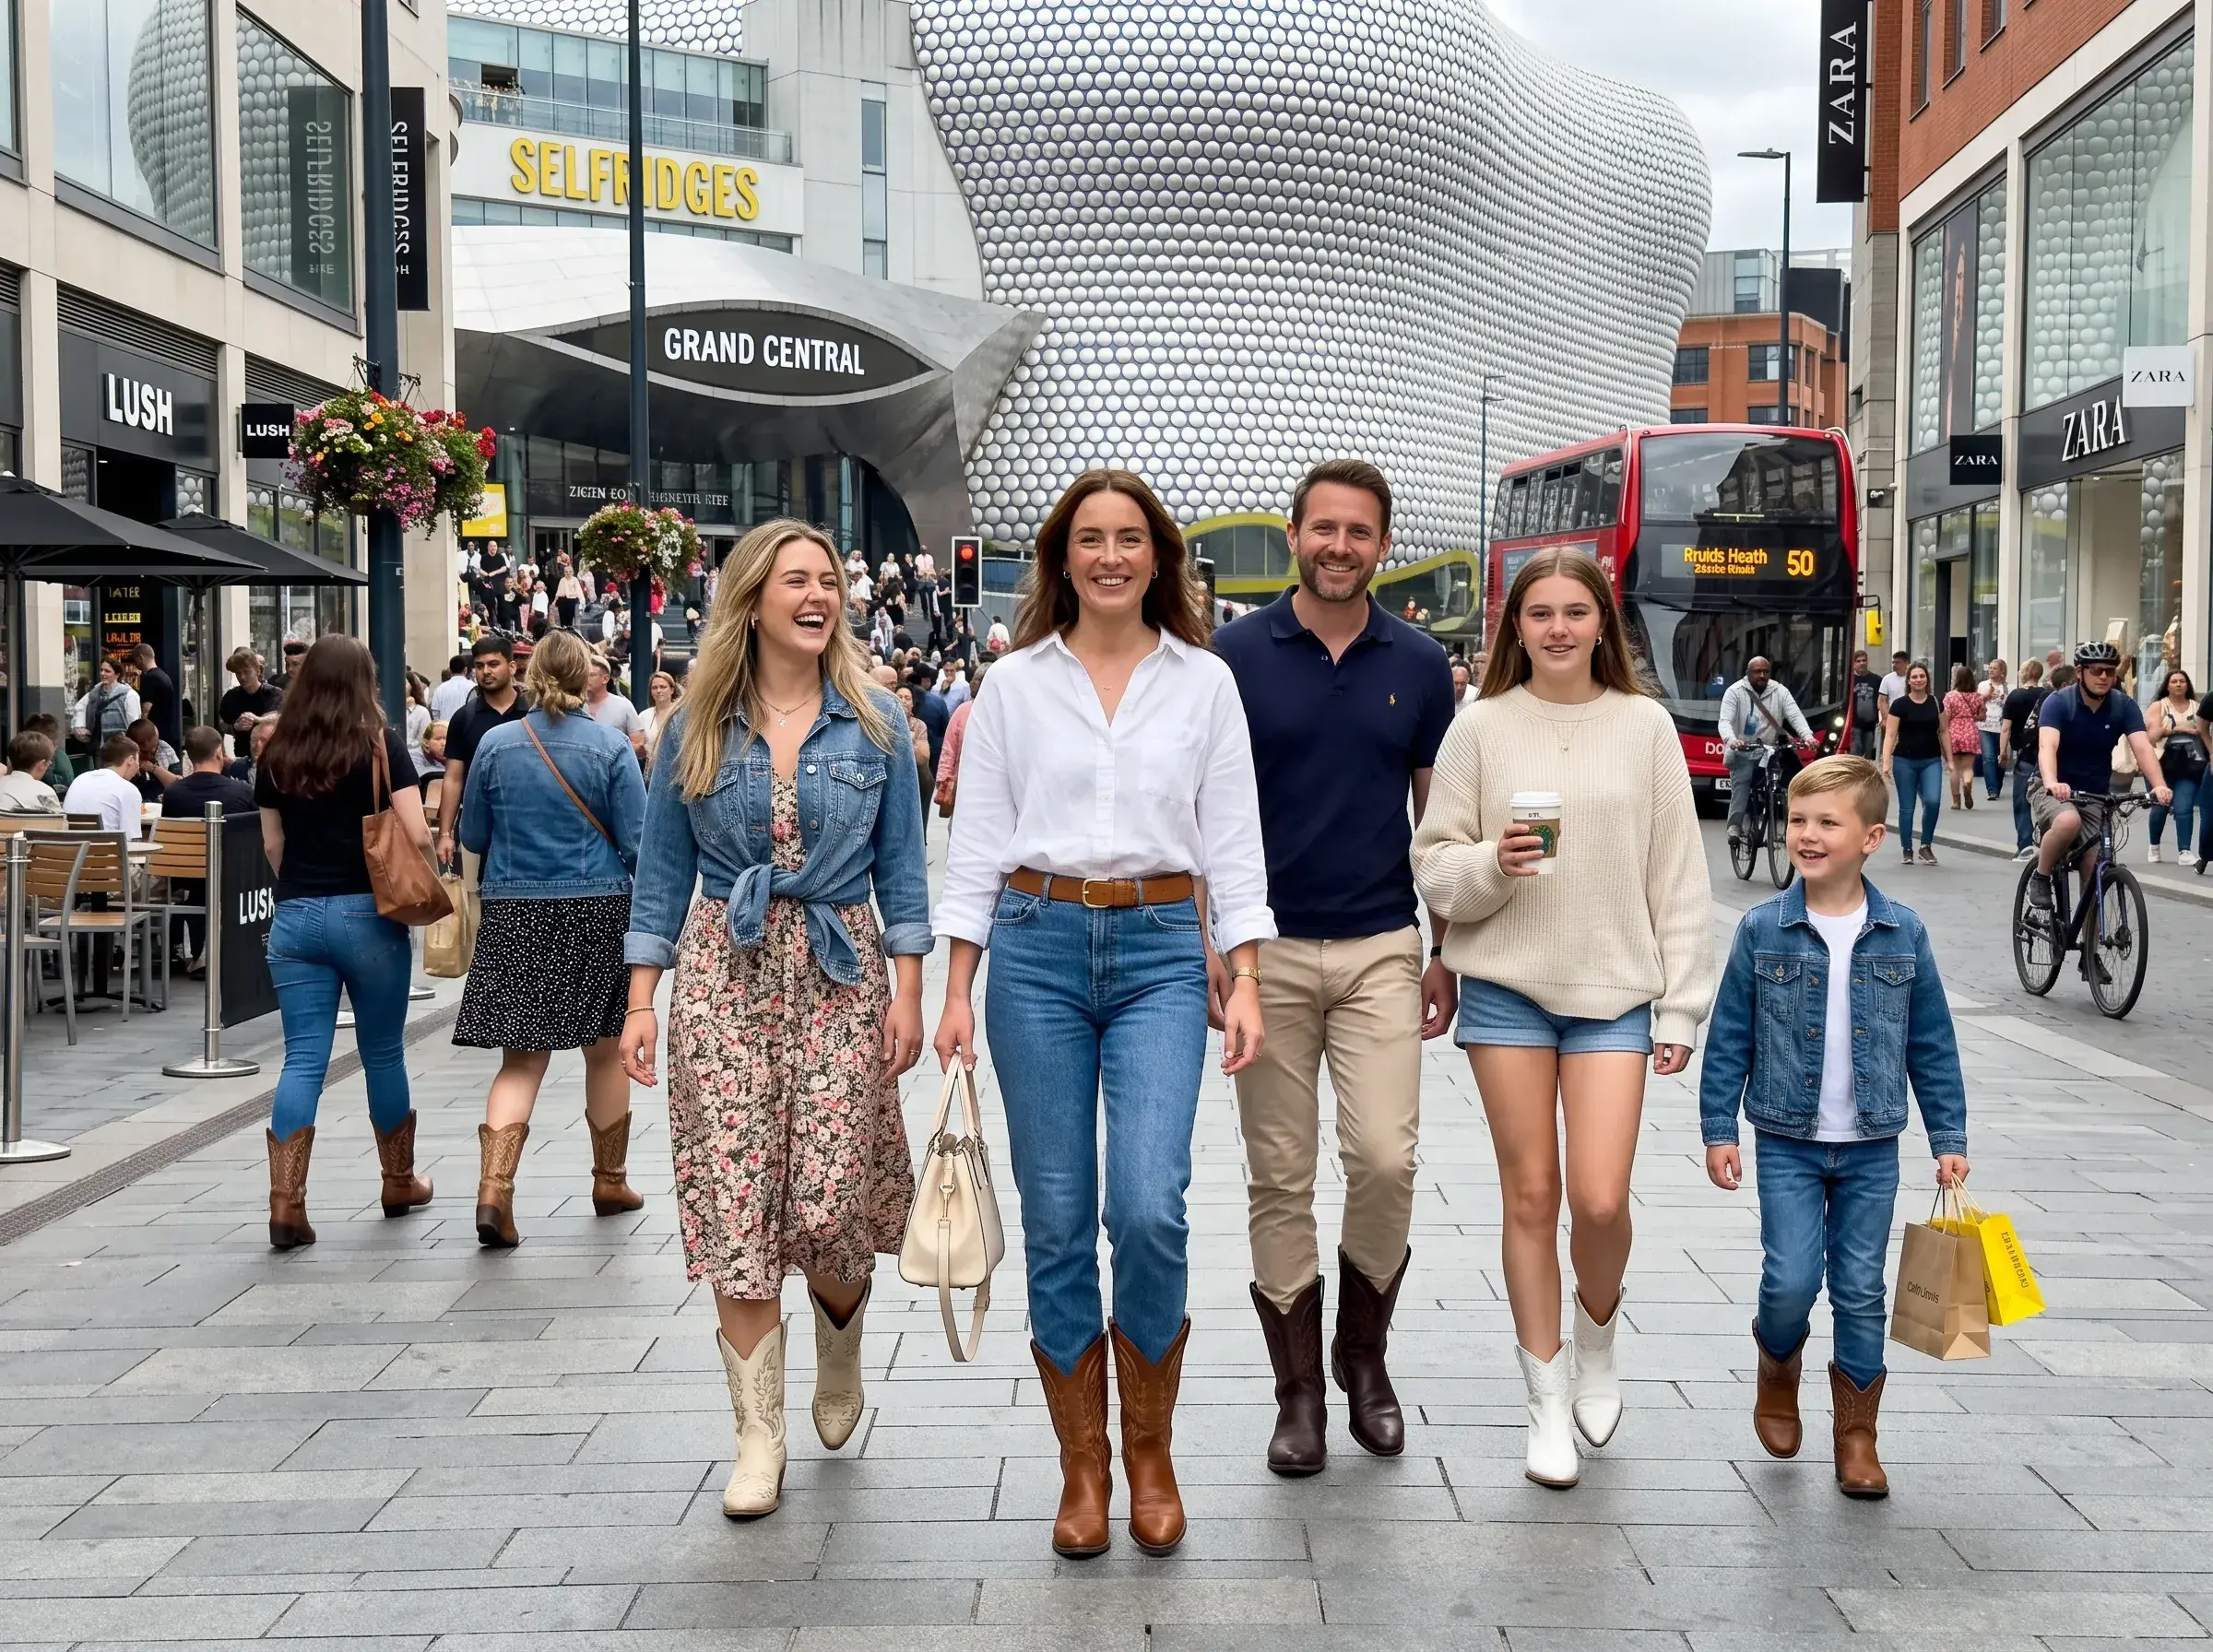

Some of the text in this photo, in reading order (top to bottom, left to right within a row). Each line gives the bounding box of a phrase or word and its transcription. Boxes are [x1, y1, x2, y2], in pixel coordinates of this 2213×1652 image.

[1828, 21, 1856, 145] ZARA
[510, 137, 760, 220] SELFRIDGES
[664, 327, 865, 375] GRAND CENTRAL
[2130, 370, 2186, 383] ZARA
[106, 372, 173, 436] LUSH
[246, 424, 290, 437] LUSH
[2062, 395, 2126, 462] ZARA
[1954, 454, 1998, 466] ZARA
[1728, 548, 1768, 564] Heath
[1787, 549, 1814, 576] 50
